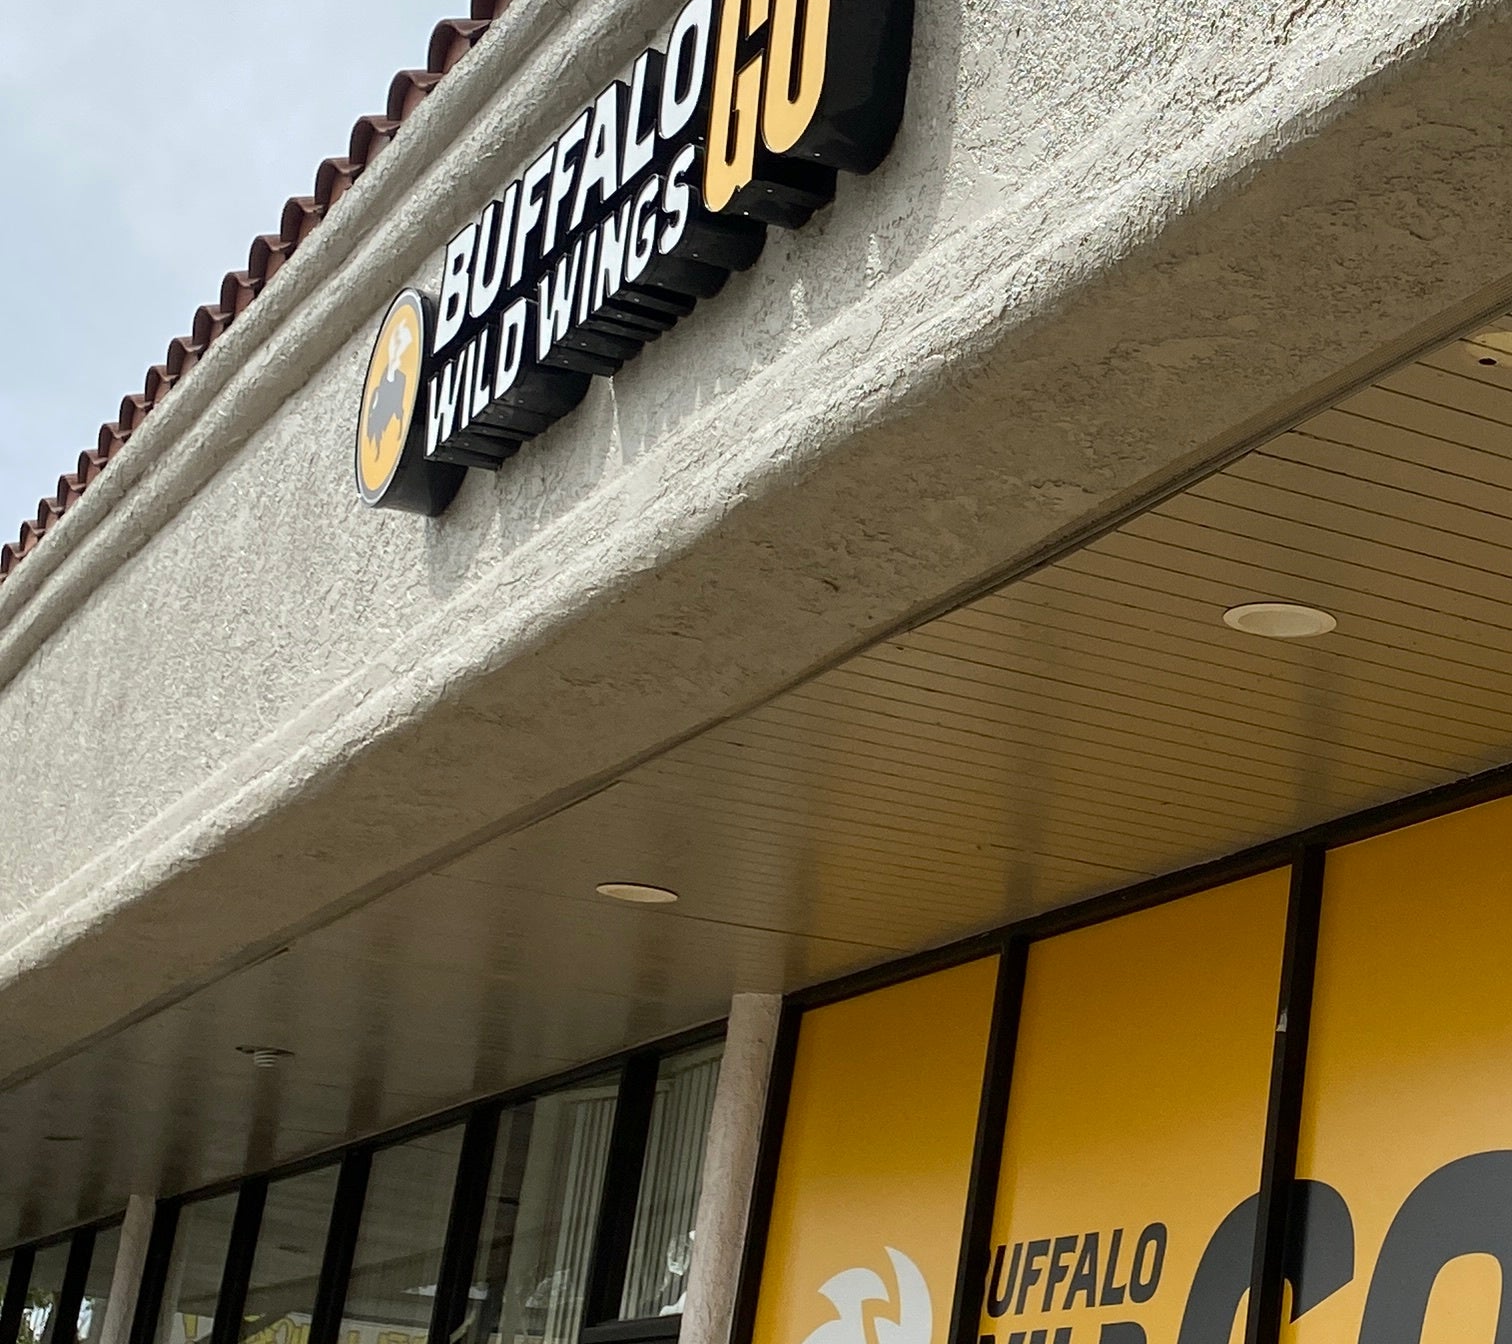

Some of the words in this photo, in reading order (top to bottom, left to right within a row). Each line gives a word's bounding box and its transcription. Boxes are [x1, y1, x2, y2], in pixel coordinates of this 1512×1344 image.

[425, 298, 527, 457] WILD
[538, 143, 697, 363] WINGS
[981, 1221, 1168, 1319] UFFALO
